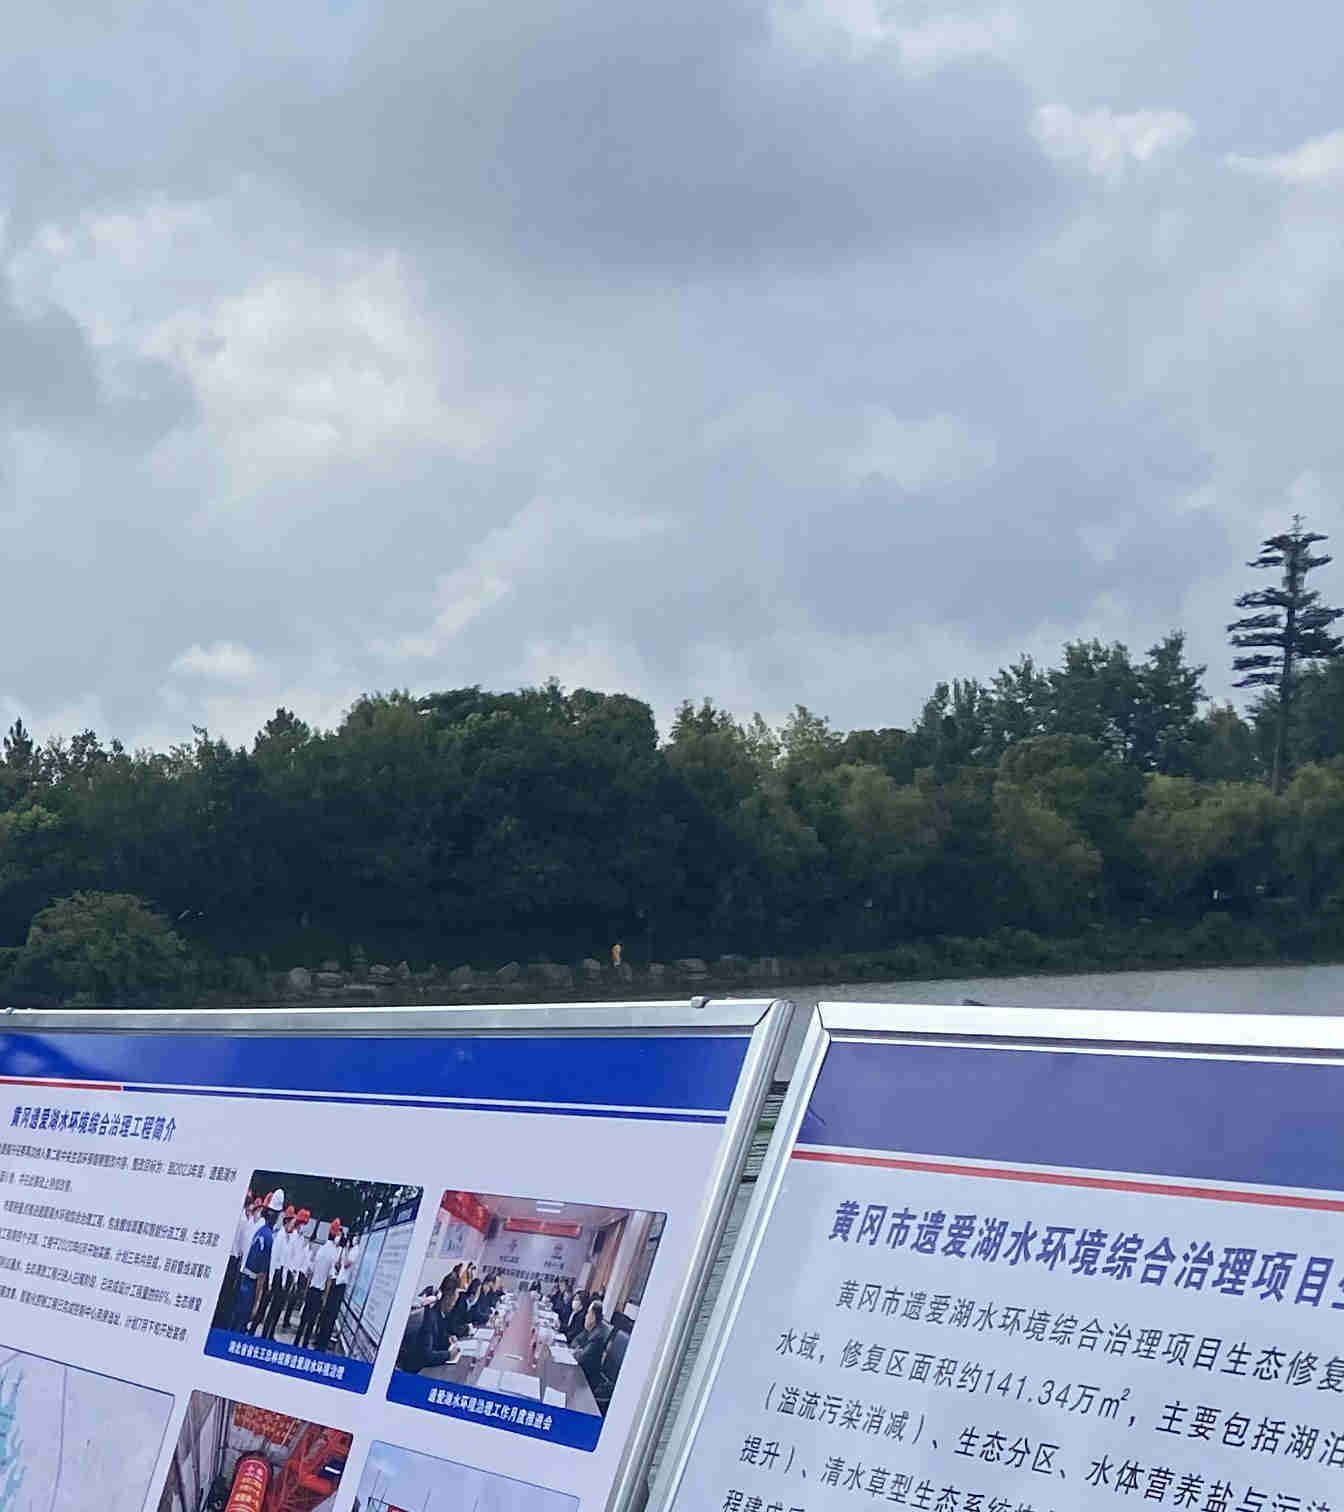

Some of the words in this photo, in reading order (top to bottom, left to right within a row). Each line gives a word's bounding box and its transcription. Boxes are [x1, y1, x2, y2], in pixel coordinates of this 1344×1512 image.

[835, 1279, 1344, 1392] 黄冈市遗爱湖水环境综合治理项目生态修复
